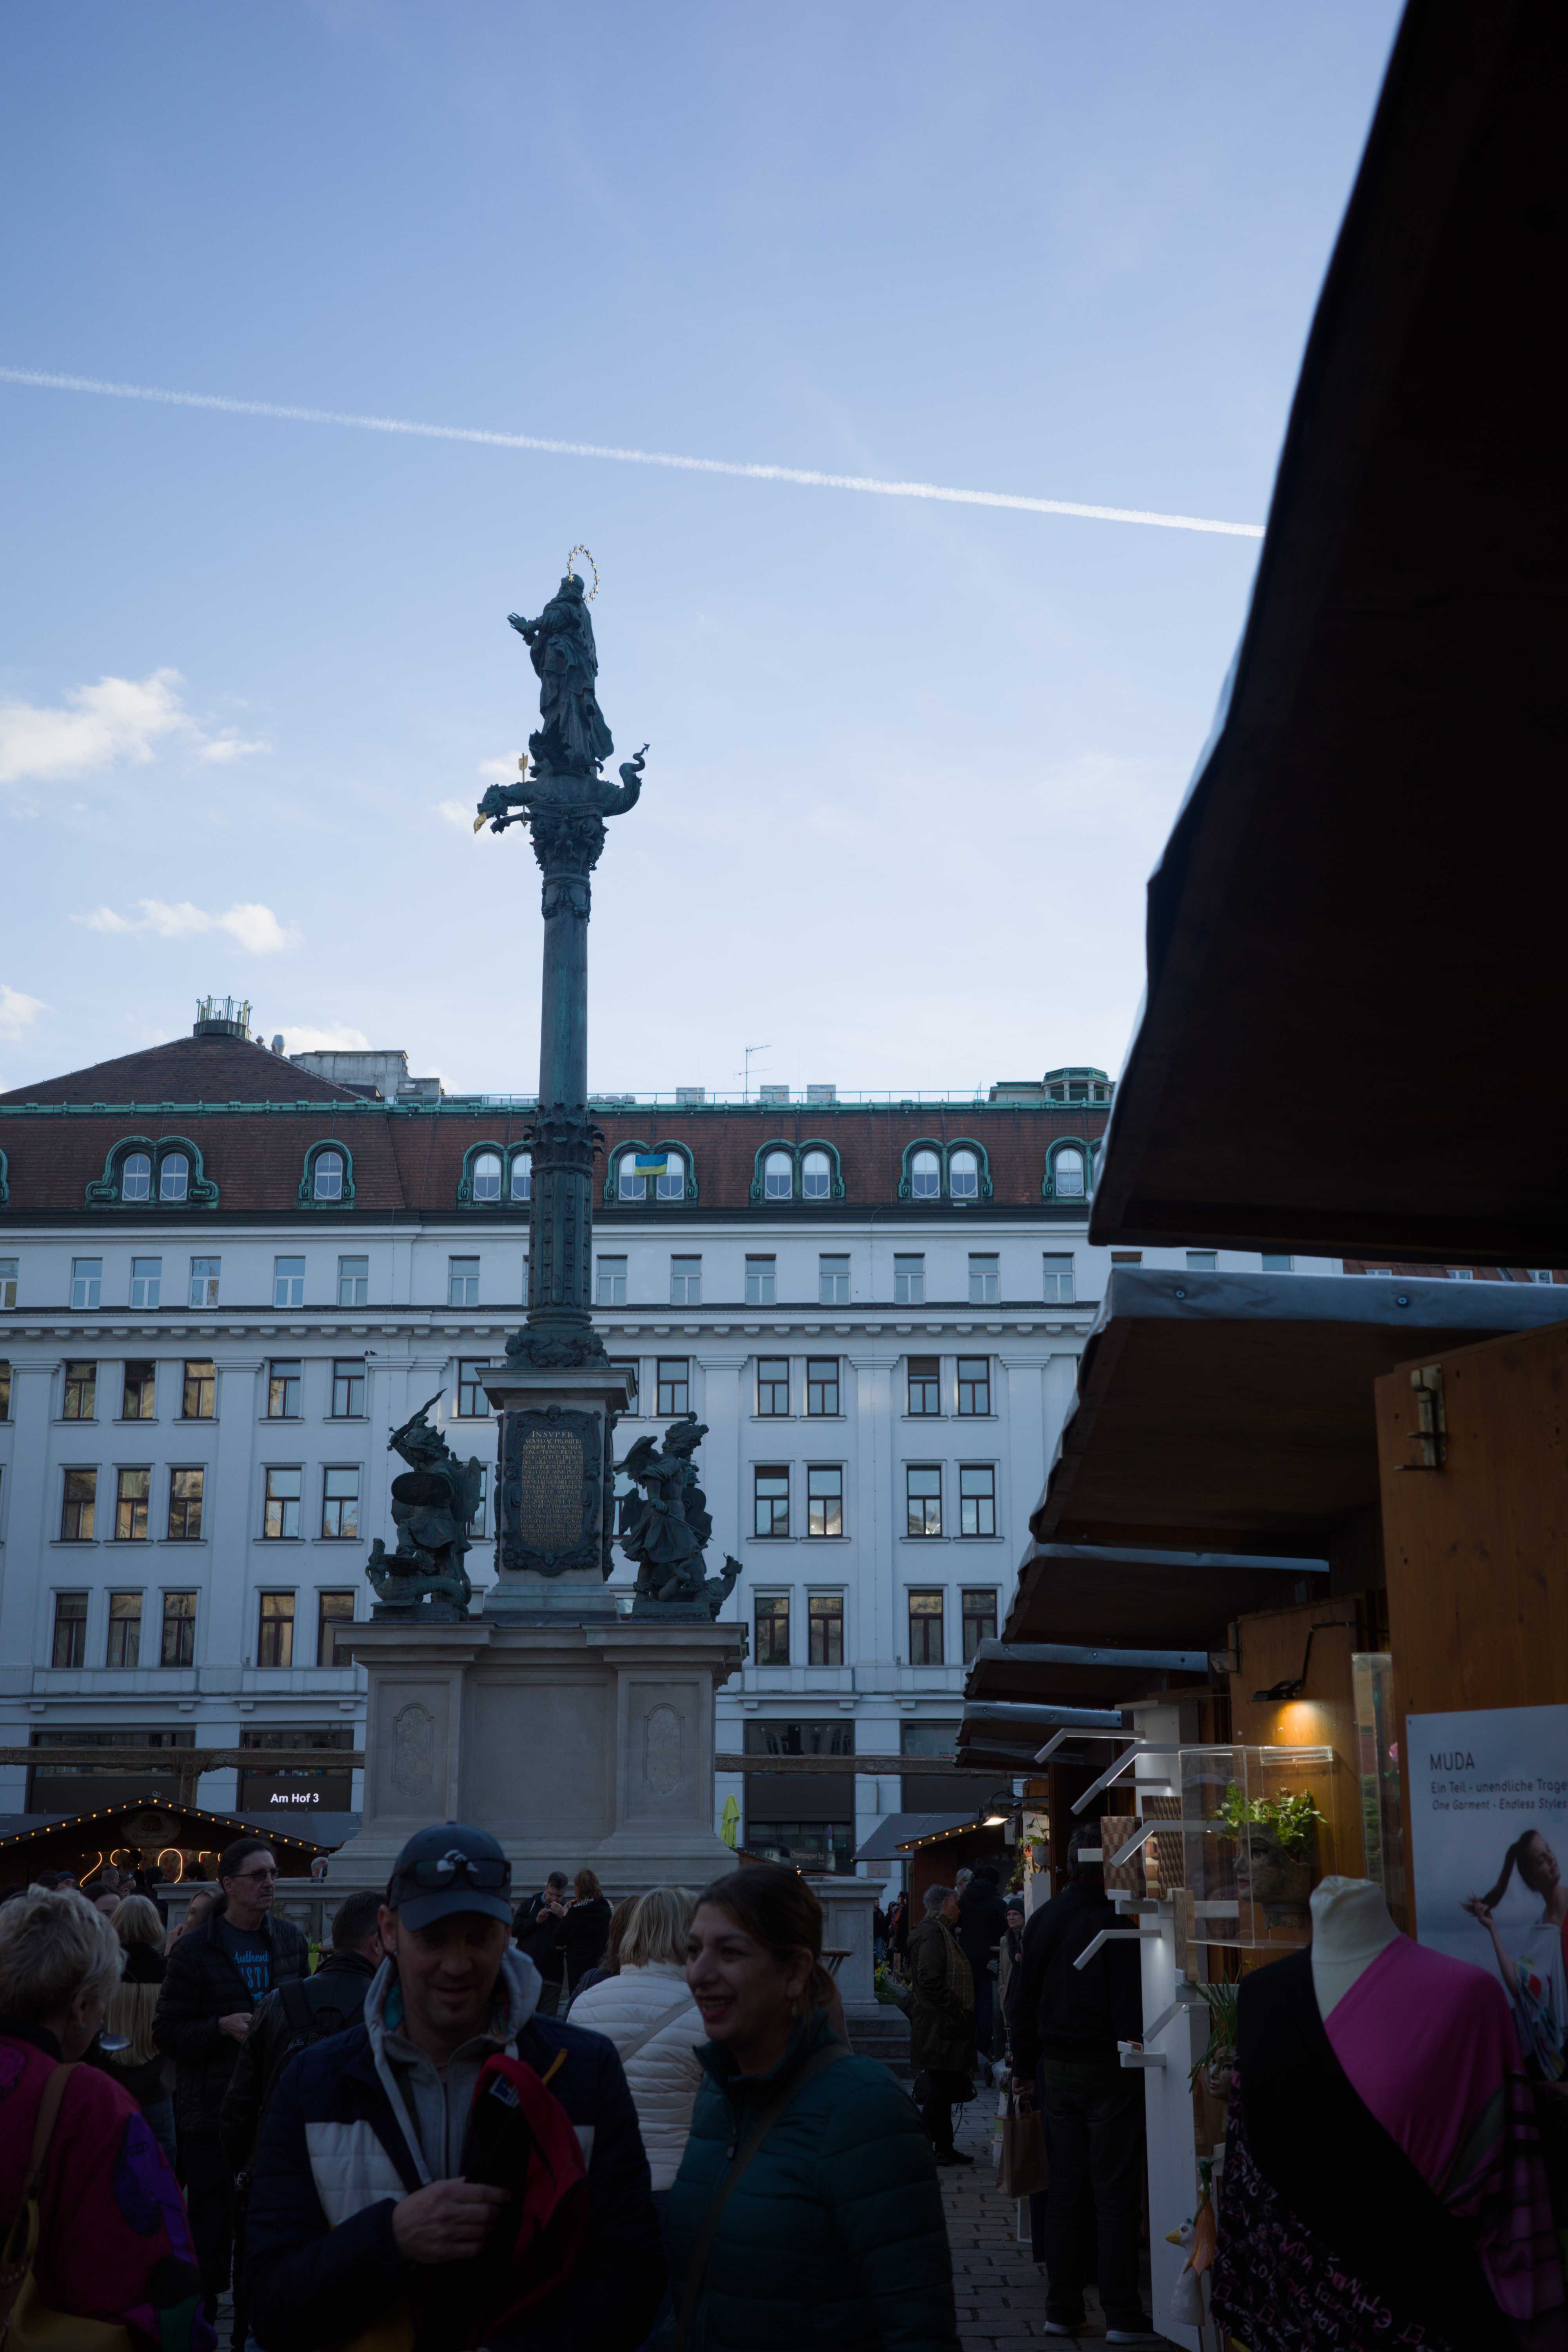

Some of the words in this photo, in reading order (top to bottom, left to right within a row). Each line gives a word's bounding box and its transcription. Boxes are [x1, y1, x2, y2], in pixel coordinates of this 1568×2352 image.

[1430, 1751, 1475, 1771] MUDA
[1431, 1781, 1446, 1793] Ein
[1449, 1780, 1466, 1793] Teil
[1476, 1780, 1533, 1793] unendliche
[1536, 1778, 1568, 1794] Trage
[270, 1793, 289, 1803] Am
[291, 1793, 311, 1803] Hof
[312, 1793, 319, 1803] 3
[1432, 1799, 1449, 1811] One
[1452, 1799, 1489, 1810] Garment
[1499, 1798, 1535, 1809] Endless
[1539, 1797, 1568, 1811] Styles
[791, 1851, 817, 1861] Champagner
